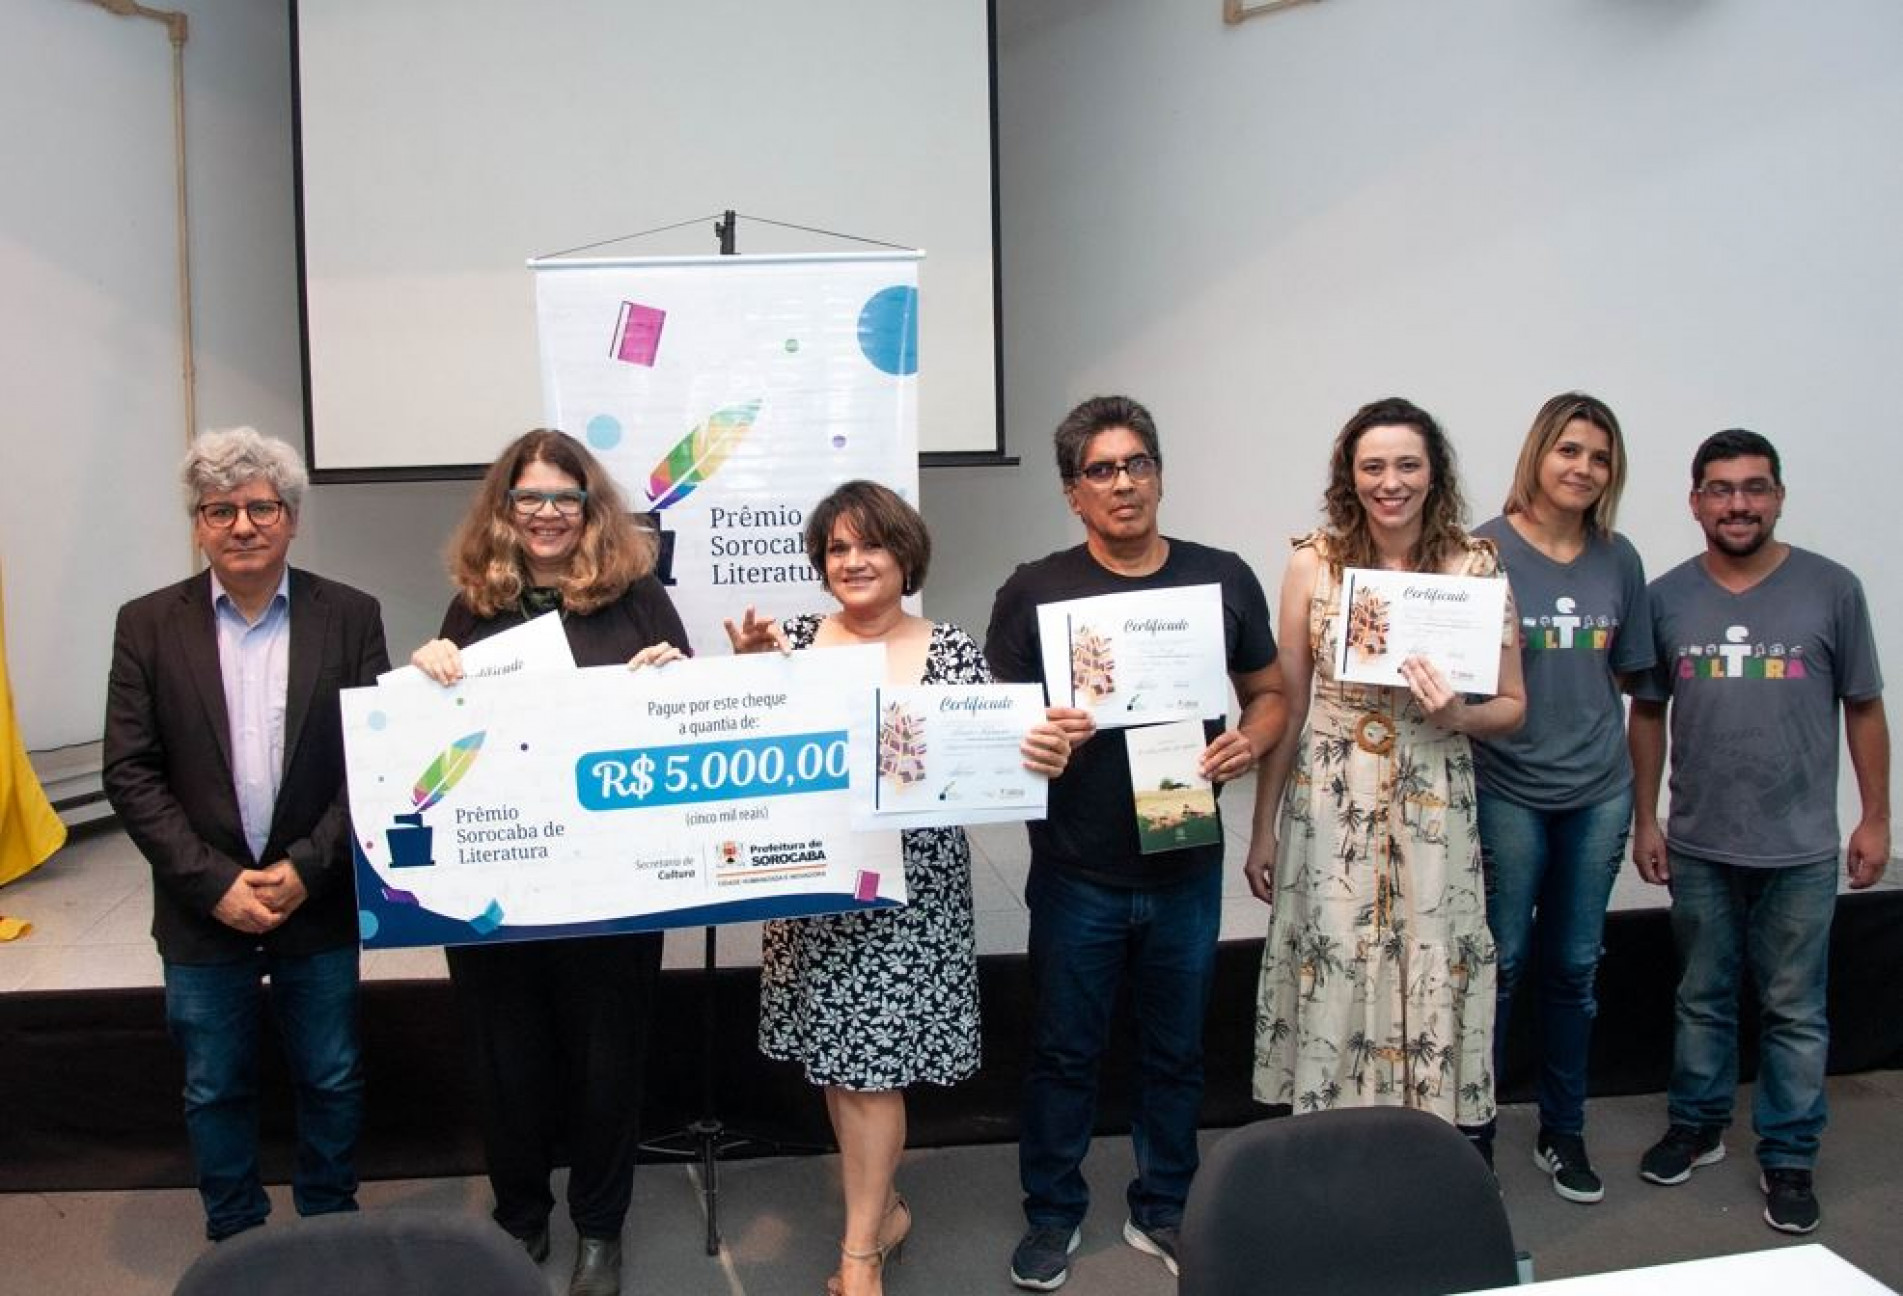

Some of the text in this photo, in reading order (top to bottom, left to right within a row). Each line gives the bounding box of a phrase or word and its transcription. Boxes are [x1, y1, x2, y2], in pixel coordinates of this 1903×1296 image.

[710, 505, 802, 528] Prêmio
[711, 532, 804, 556] Soroca
[712, 563, 821, 585] Literatu
[648, 693, 787, 719] Pague por este cheque
[940, 696, 1013, 717] Certificado
[679, 715, 760, 737] a quantia de:
[592, 740, 848, 800] R$ 5.000,00
[456, 804, 519, 824] Prêmio
[685, 806, 769, 827] (cinco mil reais)
[457, 821, 564, 843] Sorocaba de
[459, 846, 548, 864] Literatura
[750, 838, 822, 854] Prefeitura de
[752, 850, 826, 866] SOROCABA
[658, 869, 696, 880] Cultura
